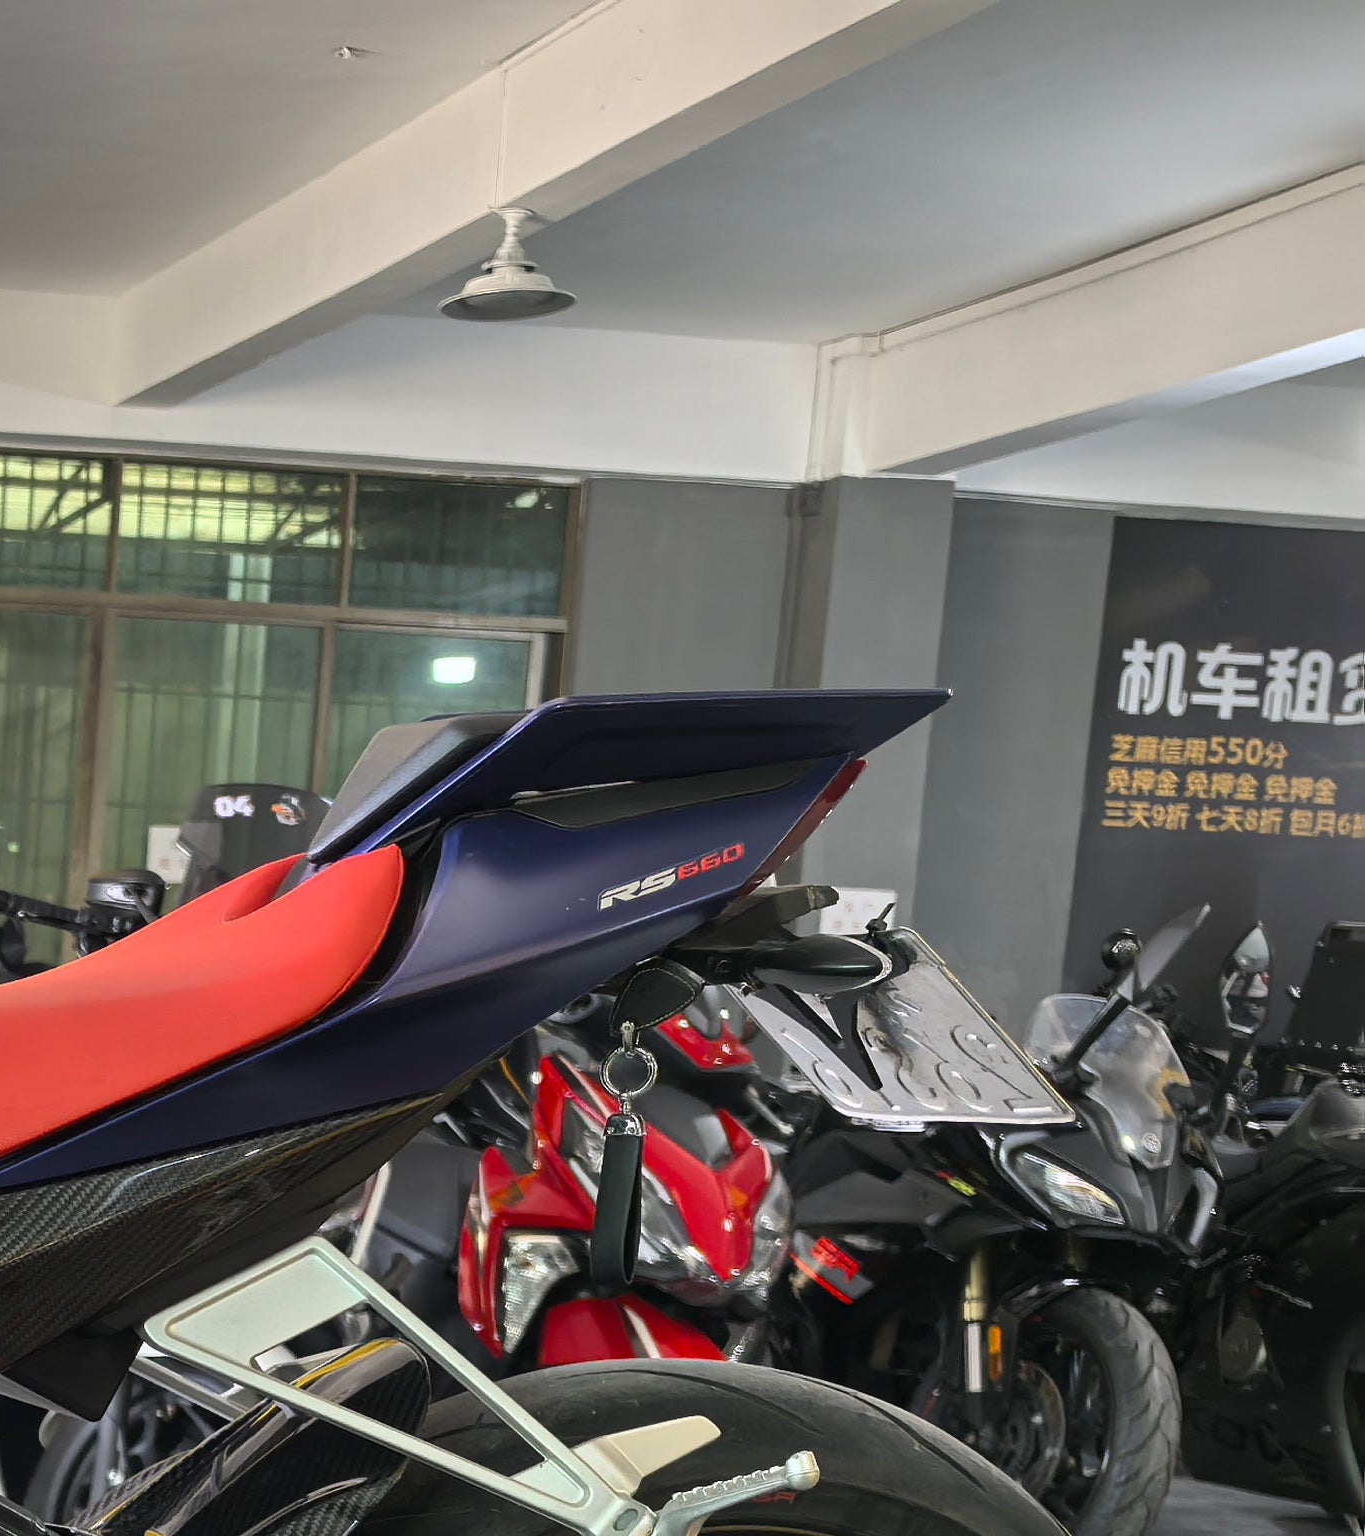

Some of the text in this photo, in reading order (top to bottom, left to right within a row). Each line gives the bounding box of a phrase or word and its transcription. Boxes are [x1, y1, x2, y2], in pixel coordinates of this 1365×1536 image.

[1108, 733, 1289, 769] 芝麻信用550分
[1105, 766, 1338, 806] 免押金 免押金 免押金
[1101, 799, 1191, 831] 三天9折
[1195, 804, 1284, 835] 七天8折
